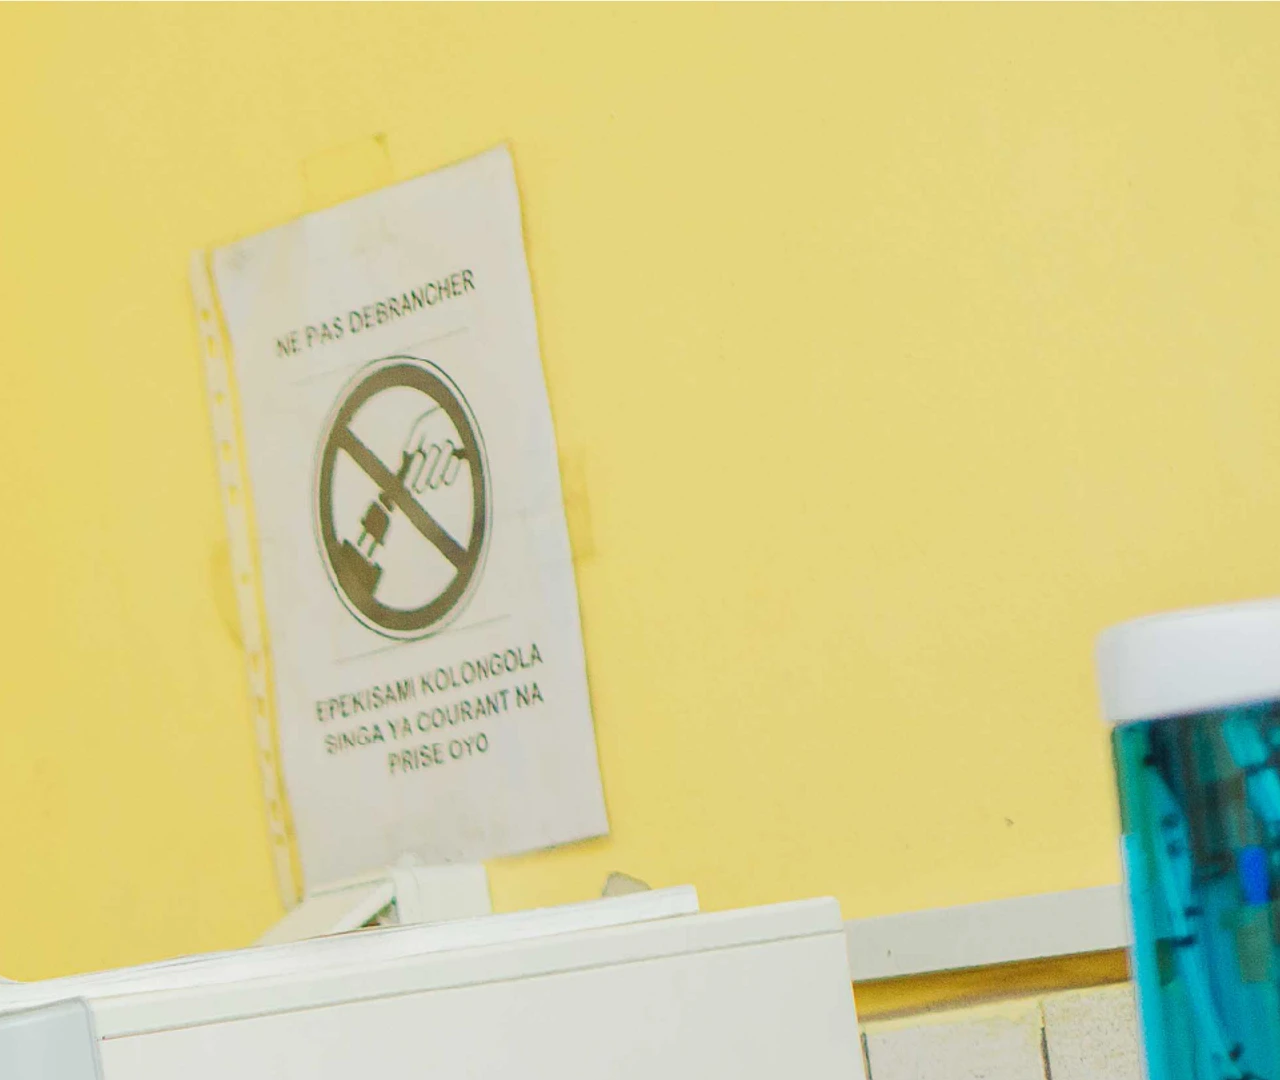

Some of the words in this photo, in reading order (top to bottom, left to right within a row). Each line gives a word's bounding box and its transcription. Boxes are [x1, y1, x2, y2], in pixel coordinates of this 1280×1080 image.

[276, 331, 301, 358] NE
[305, 316, 344, 348] PAS
[348, 268, 476, 334] DEBRANCHER
[316, 677, 417, 722] EPEKISAMI
[420, 643, 544, 693] KOLONGOLA
[324, 723, 386, 755] SINGA
[387, 716, 414, 740] YA
[416, 688, 509, 732] COURANT
[515, 682, 545, 708] NA
[388, 742, 445, 774] PRISE
[448, 732, 489, 760] OYO
